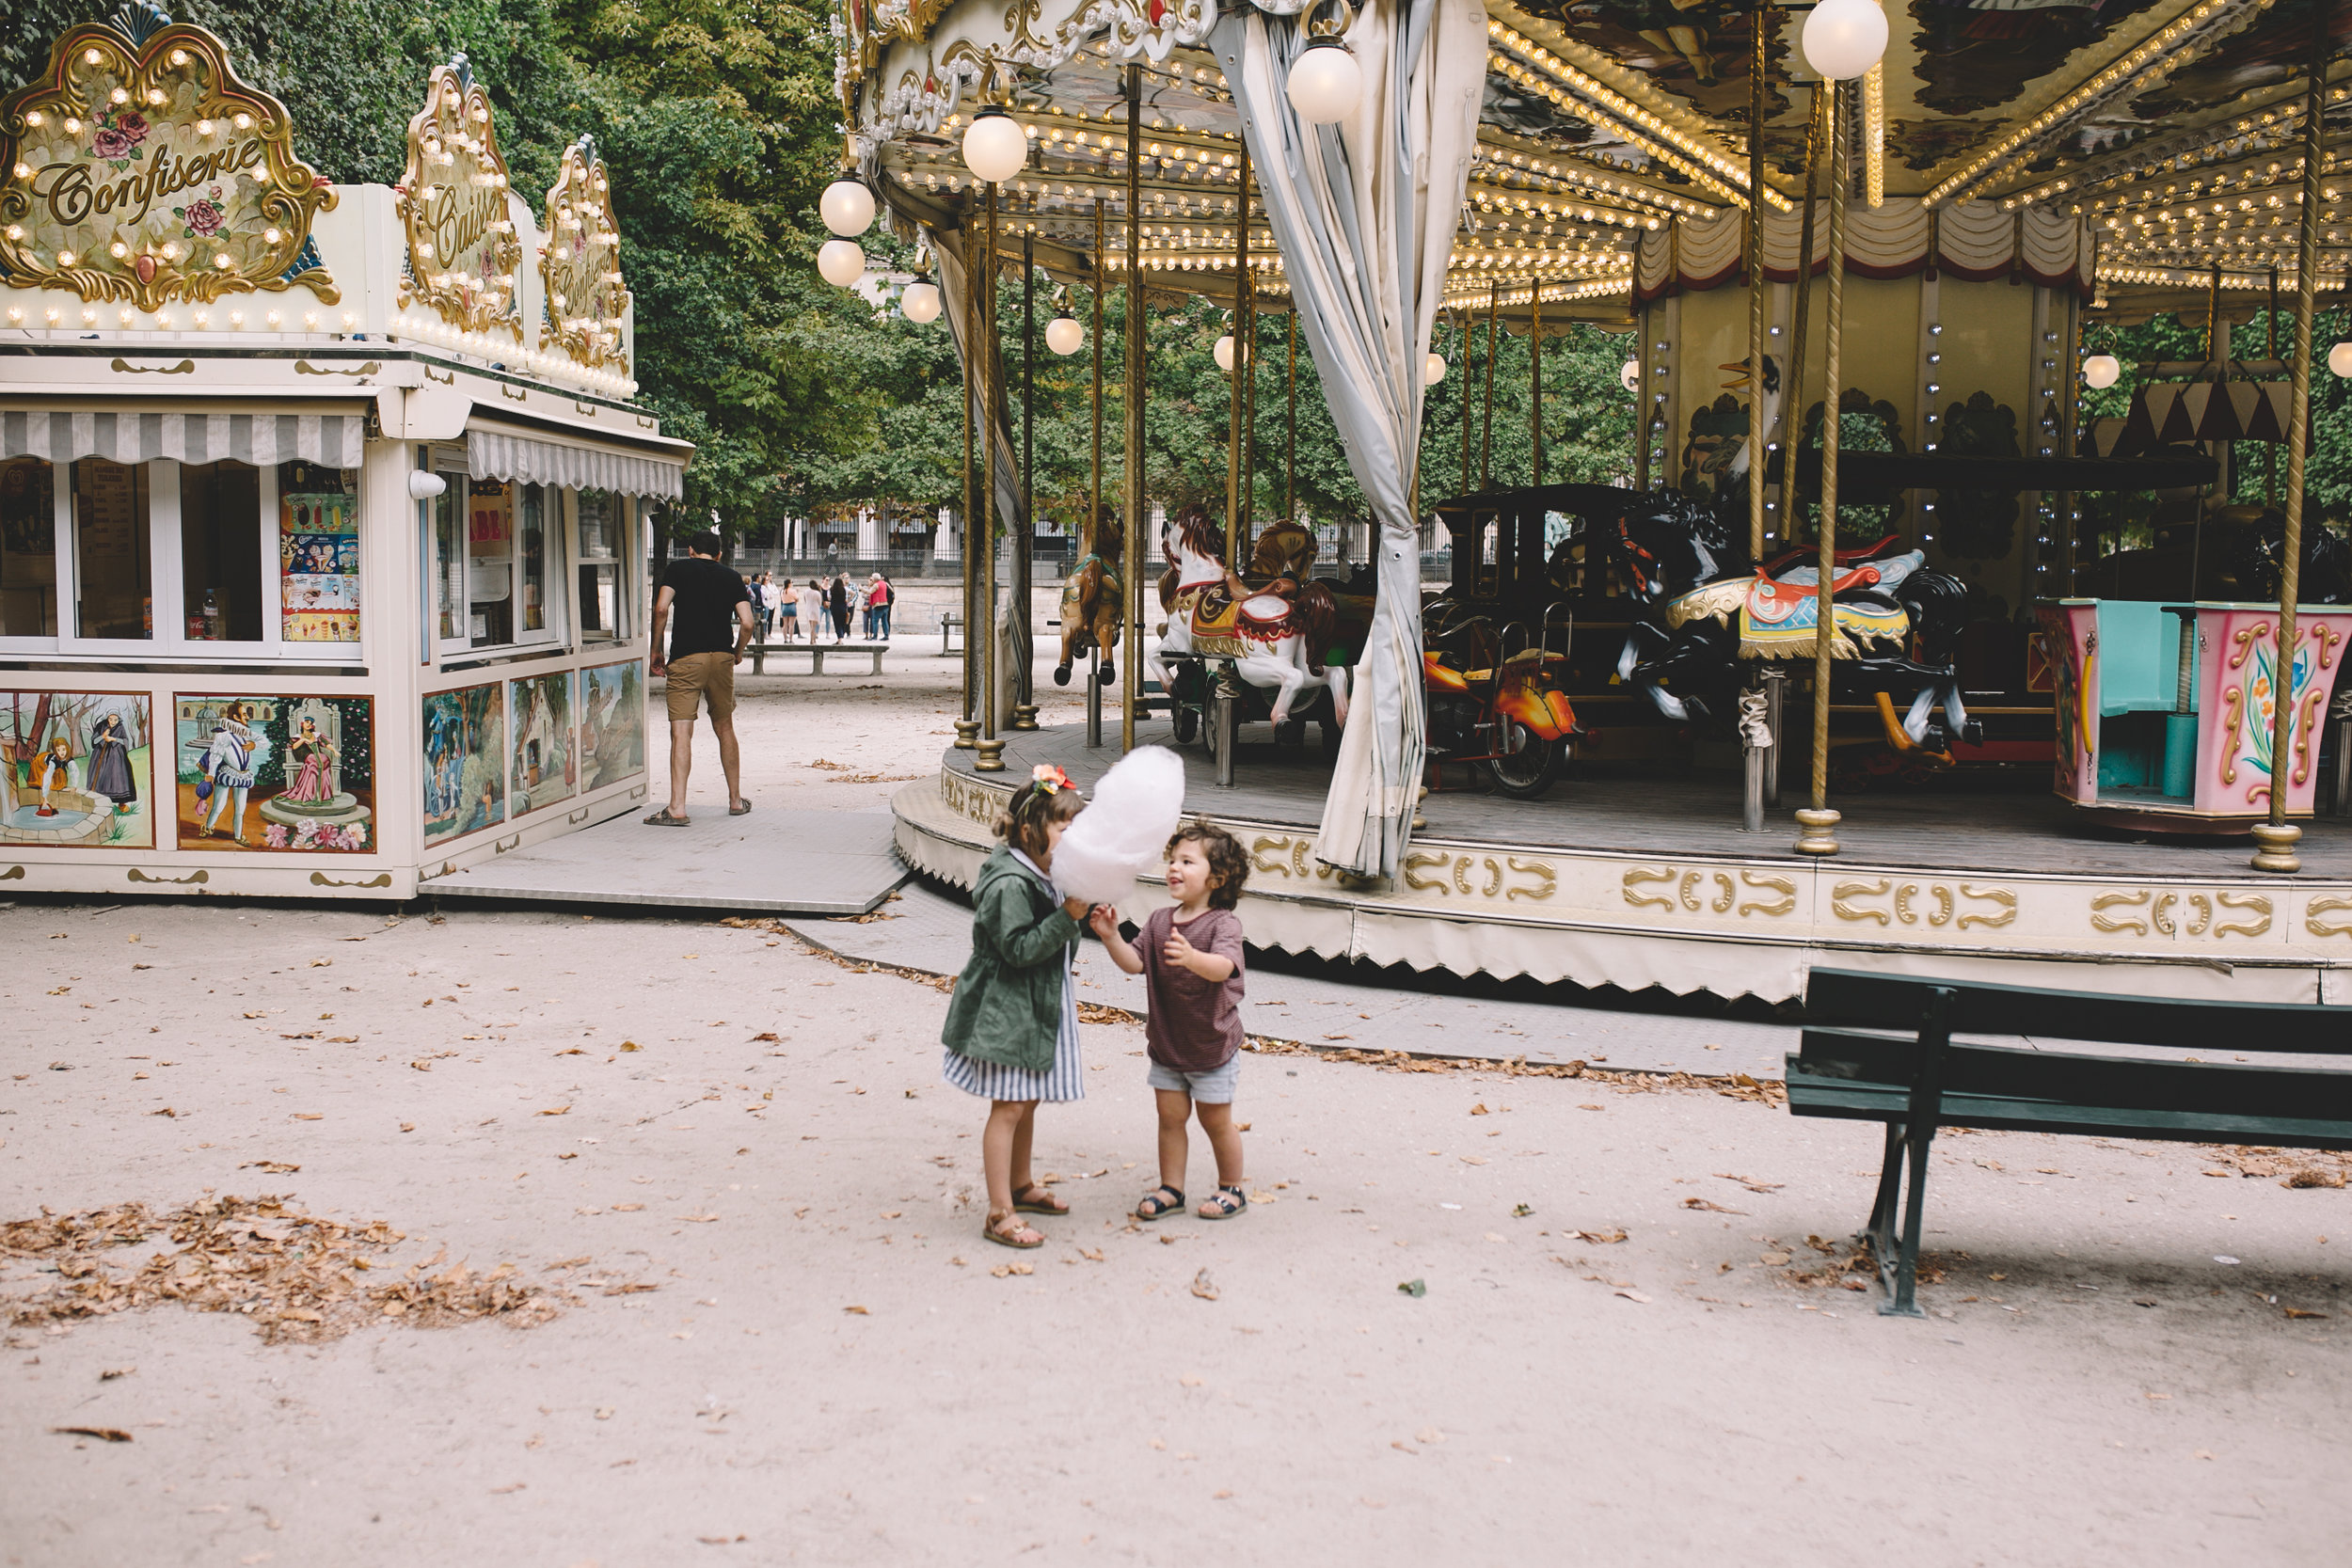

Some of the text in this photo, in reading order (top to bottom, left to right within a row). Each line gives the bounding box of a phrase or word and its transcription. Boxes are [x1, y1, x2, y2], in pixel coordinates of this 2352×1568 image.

[29, 138, 262, 226] Confiserie
[425, 182, 498, 269] Caisse
[558, 245, 612, 316] Confiserie
